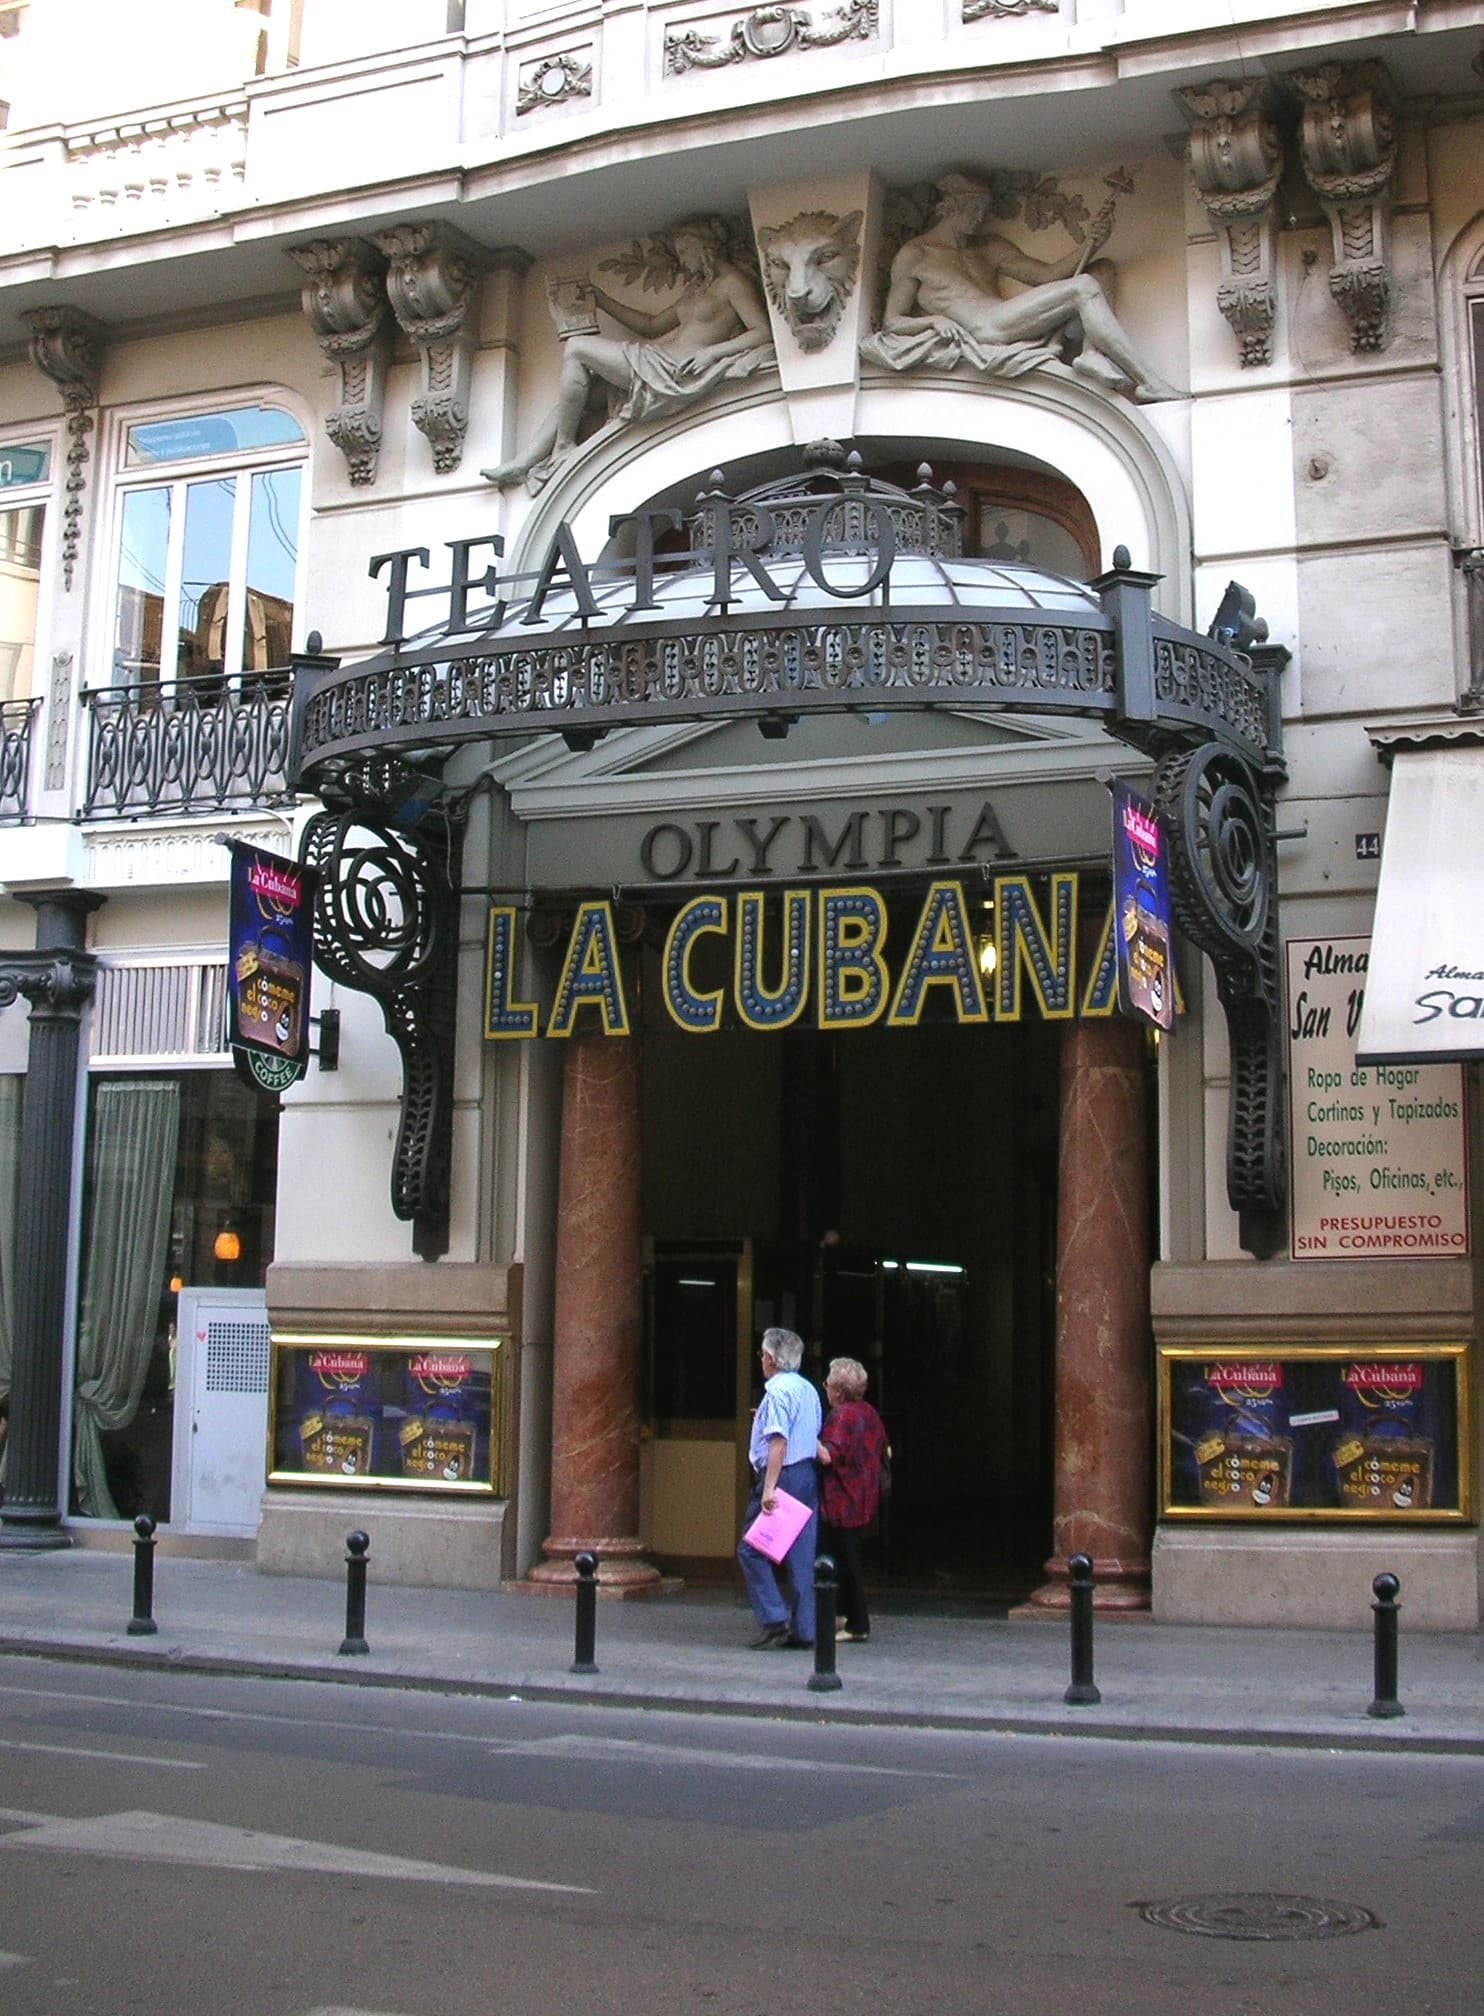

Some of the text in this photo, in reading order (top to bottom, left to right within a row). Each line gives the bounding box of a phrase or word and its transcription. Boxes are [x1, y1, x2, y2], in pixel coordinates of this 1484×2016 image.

[368, 499, 896, 646] TEATRO
[640, 801, 1018, 879] OLYMPIA
[1357, 837, 1379, 856] 44
[485, 901, 630, 1039] LA
[1292, 991, 1331, 1040] San
[255, 1061, 293, 1086] COFFEE
[1307, 1067, 1342, 1092] Ropa
[1376, 1066, 1420, 1091] Hogar
[1307, 1096, 1459, 1125] Cortinas y Tapizados
[1307, 1133, 1388, 1157] Decoración:
[1323, 1169, 1361, 1194] Pisos,
[1370, 1167, 1430, 1191] Oficinas,
[1320, 1215, 1442, 1231] PRESUPUESTO
[1298, 1233, 1466, 1250] SIN COMPROMISO
[1223, 1366, 1277, 1381] Cubana
[1361, 1367, 1417, 1382] Cubana
